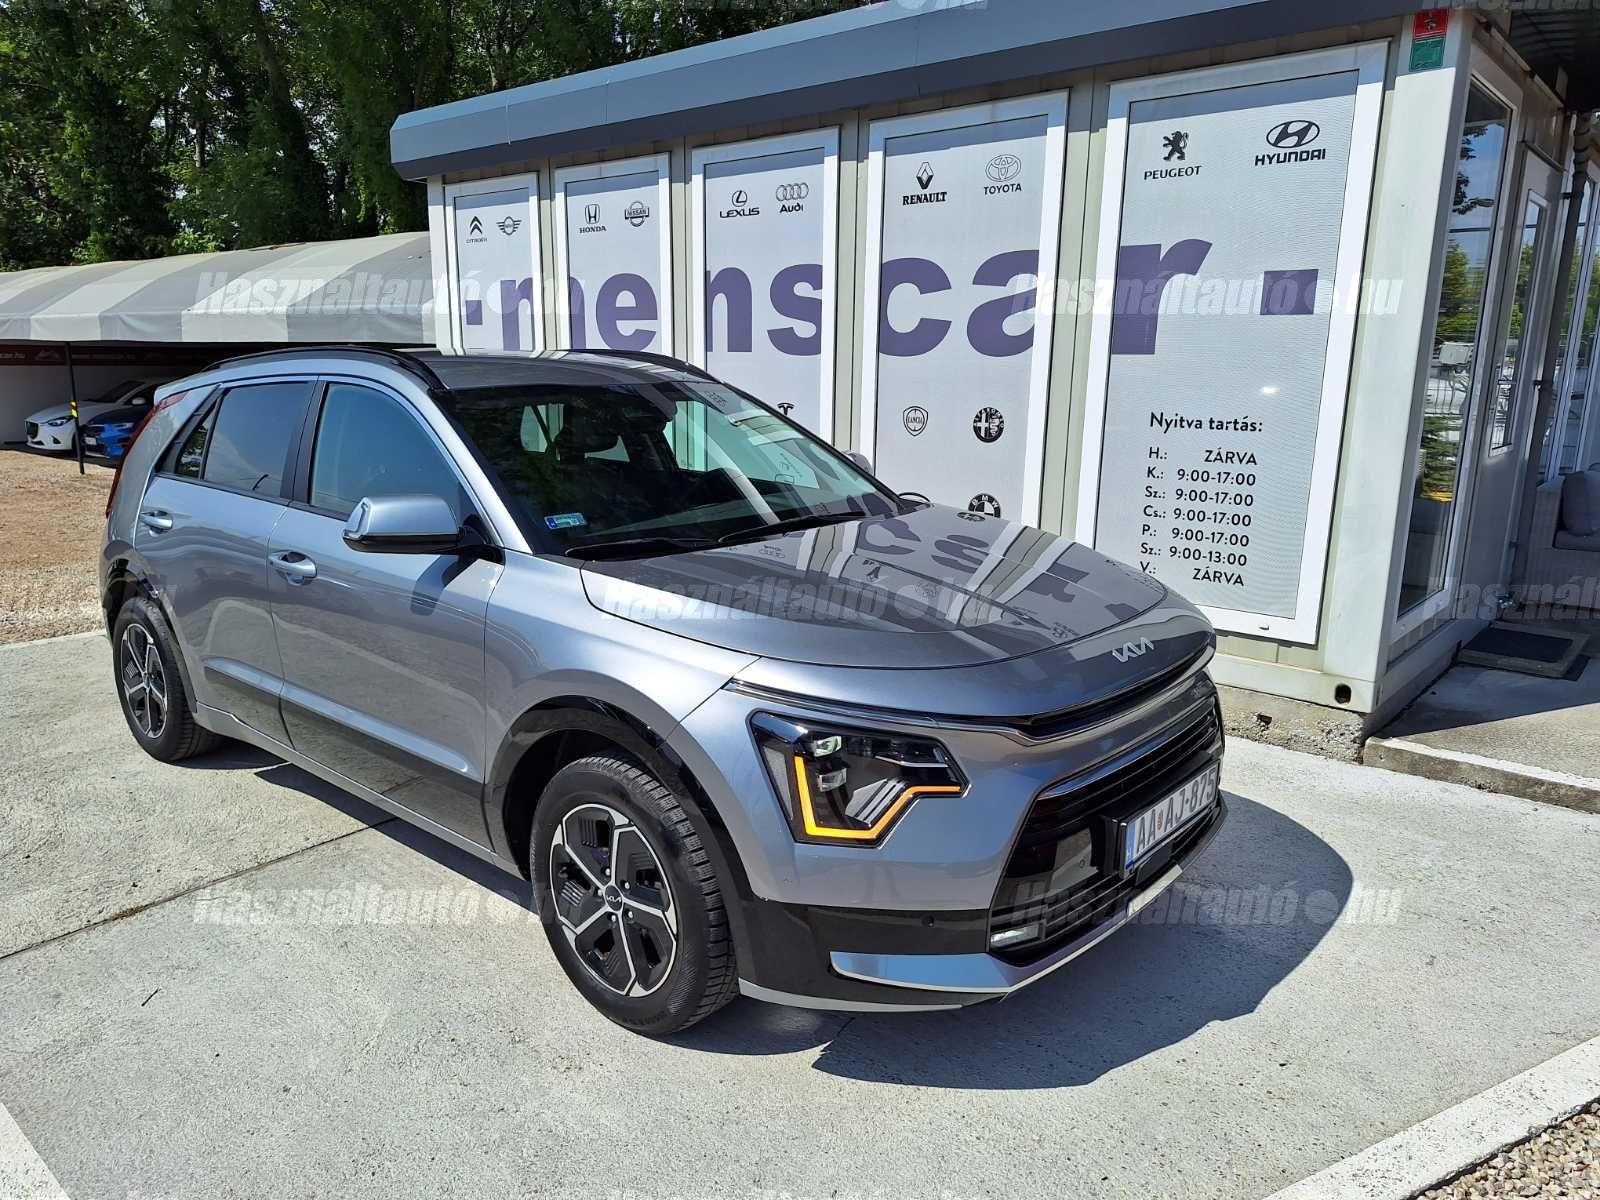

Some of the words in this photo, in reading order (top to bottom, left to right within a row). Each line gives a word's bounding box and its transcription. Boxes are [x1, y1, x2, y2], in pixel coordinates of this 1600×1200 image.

[1254, 149, 1326, 167] HYUNDAI
[1143, 165, 1202, 181] PEUGEOT
[902, 191, 948, 206] RENAULT
[983, 183, 1022, 196] TOYOTA
[719, 207, 760, 219] LEXUS
[779, 203, 804, 214] Audi
[579, 225, 607, 234] HONDA
[1149, 412, 1203, 434] Nyitva
[1208, 415, 1263, 432] tartás:
[1148, 446, 1168, 460] H.:
[1203, 447, 1258, 466] ZÁRVA
[1146, 466, 1164, 479] K.:
[1176, 468, 1257, 486] 9:00-17:00
[1145, 486, 1166, 499] Sz.:
[1175, 488, 1254, 507] 9:00-17:00
[1143, 505, 1166, 519] Cs.:
[1173, 508, 1252, 527] 9:00-17:00
[1141, 524, 1157, 537] P.:
[1171, 527, 1250, 547] 9:00-17:00
[1140, 542, 1162, 556] Sz.:
[1169, 546, 1248, 567] 9:00-13:00
[1140, 561, 1157, 575] V.:
[1192, 566, 1245, 587] ZÁRVA
